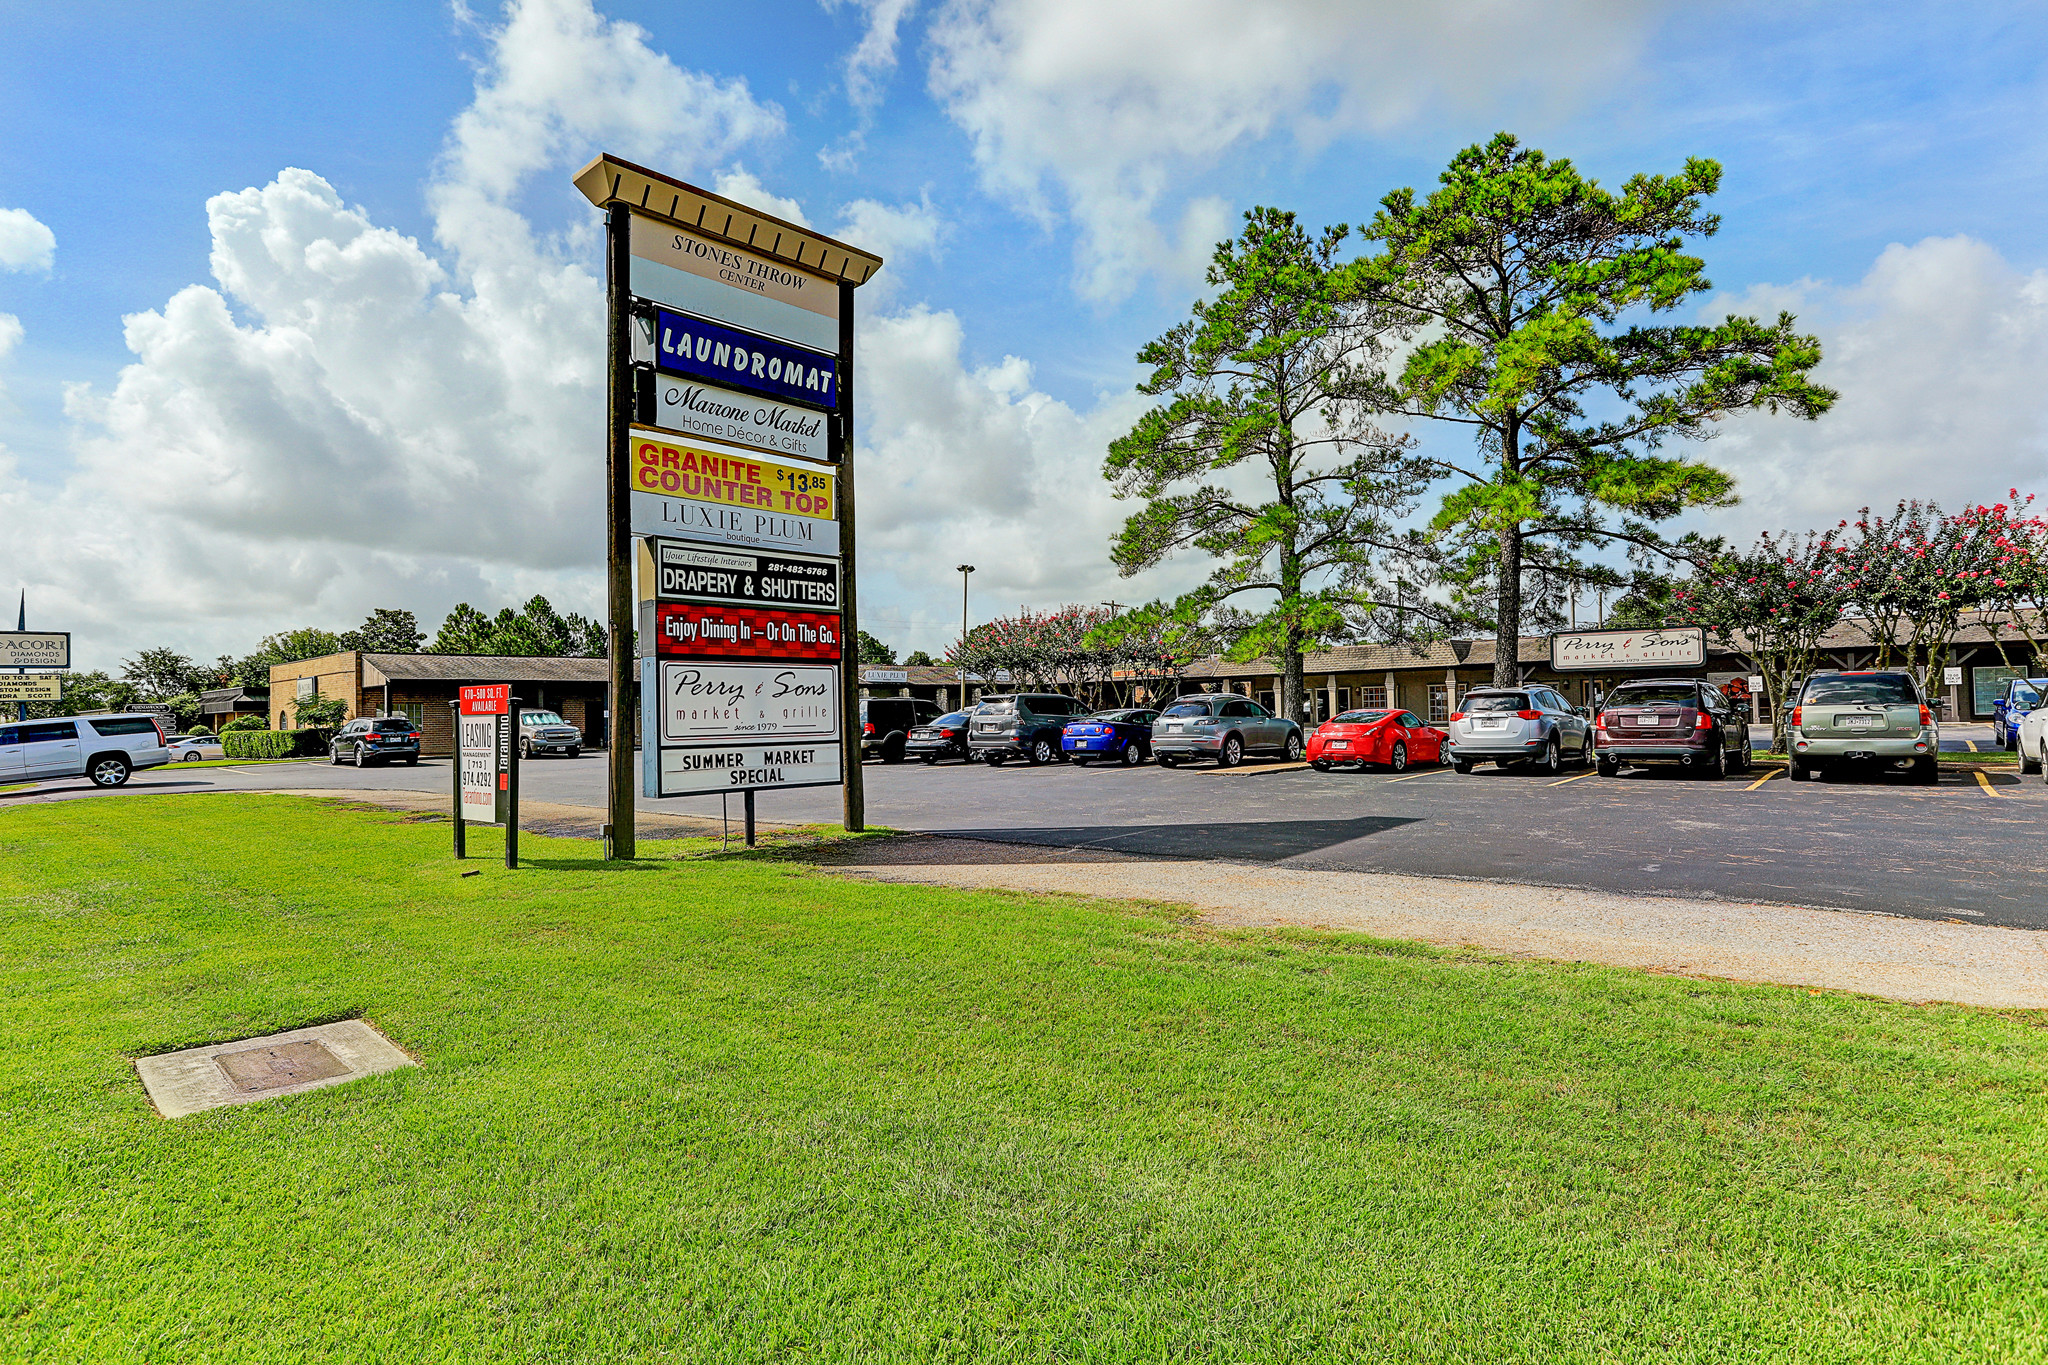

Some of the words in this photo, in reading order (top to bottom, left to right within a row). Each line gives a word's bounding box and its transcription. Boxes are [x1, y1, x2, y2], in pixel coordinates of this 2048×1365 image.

[672, 234, 743, 270] STONES
[747, 259, 808, 290] THROW
[719, 268, 766, 292] CENTER
[662, 328, 834, 394] LAUNDROMAT
[664, 384, 750, 423] Marrone
[754, 406, 820, 438] Market
[682, 415, 724, 435] Home
[727, 422, 766, 444] Décor
[769, 435, 778, 447] &
[781, 437, 808, 454] Gifts
[639, 444, 762, 484] GRANITE
[638, 466, 772, 507] COUNTER
[780, 490, 828, 514] TOP
[662, 502, 743, 532] LUXIE
[754, 514, 814, 540] PLUM
[726, 532, 760, 544] boutique
[665, 551, 685, 562] Your
[687, 552, 718, 564] Lifestyle
[720, 557, 752, 567] Interiors
[768, 563, 828, 576] 281-482-6766
[664, 568, 737, 594] DRAPERY
[744, 576, 754, 596] &
[761, 576, 835, 602] SHUTTERS
[665, 616, 697, 642] Enjoy
[701, 618, 737, 644] Dining
[740, 620, 750, 640] In
[766, 622, 779, 640] Or
[782, 622, 796, 642] On
[798, 624, 816, 642] The
[819, 625, 836, 644] Go.
[4, 640, 65, 650] ACORI
[1564, 638, 1614, 653] Perry
[1622, 638, 1632, 650] &
[1640, 634, 1691, 648] Sons
[1564, 652, 1614, 660] market
[1643, 650, 1692, 658] grille
[868, 671, 887, 679] LUXIE
[674, 670, 745, 706] Perry
[754, 682, 764, 696] &
[772, 671, 827, 698] Sons
[472, 700, 497, 712] AVAILABLE
[676, 706, 740, 720] market
[759, 710, 765, 718] &
[782, 706, 827, 719] grille
[462, 723, 492, 748] LEASING
[734, 723, 755, 731] since
[757, 722, 778, 731] 1979
[499, 715, 509, 771] Tarantino
[682, 752, 744, 770] SUMMER
[764, 750, 815, 765] MARKET
[463, 772, 491, 787] 974.4292
[730, 768, 784, 784] SPECIAL
